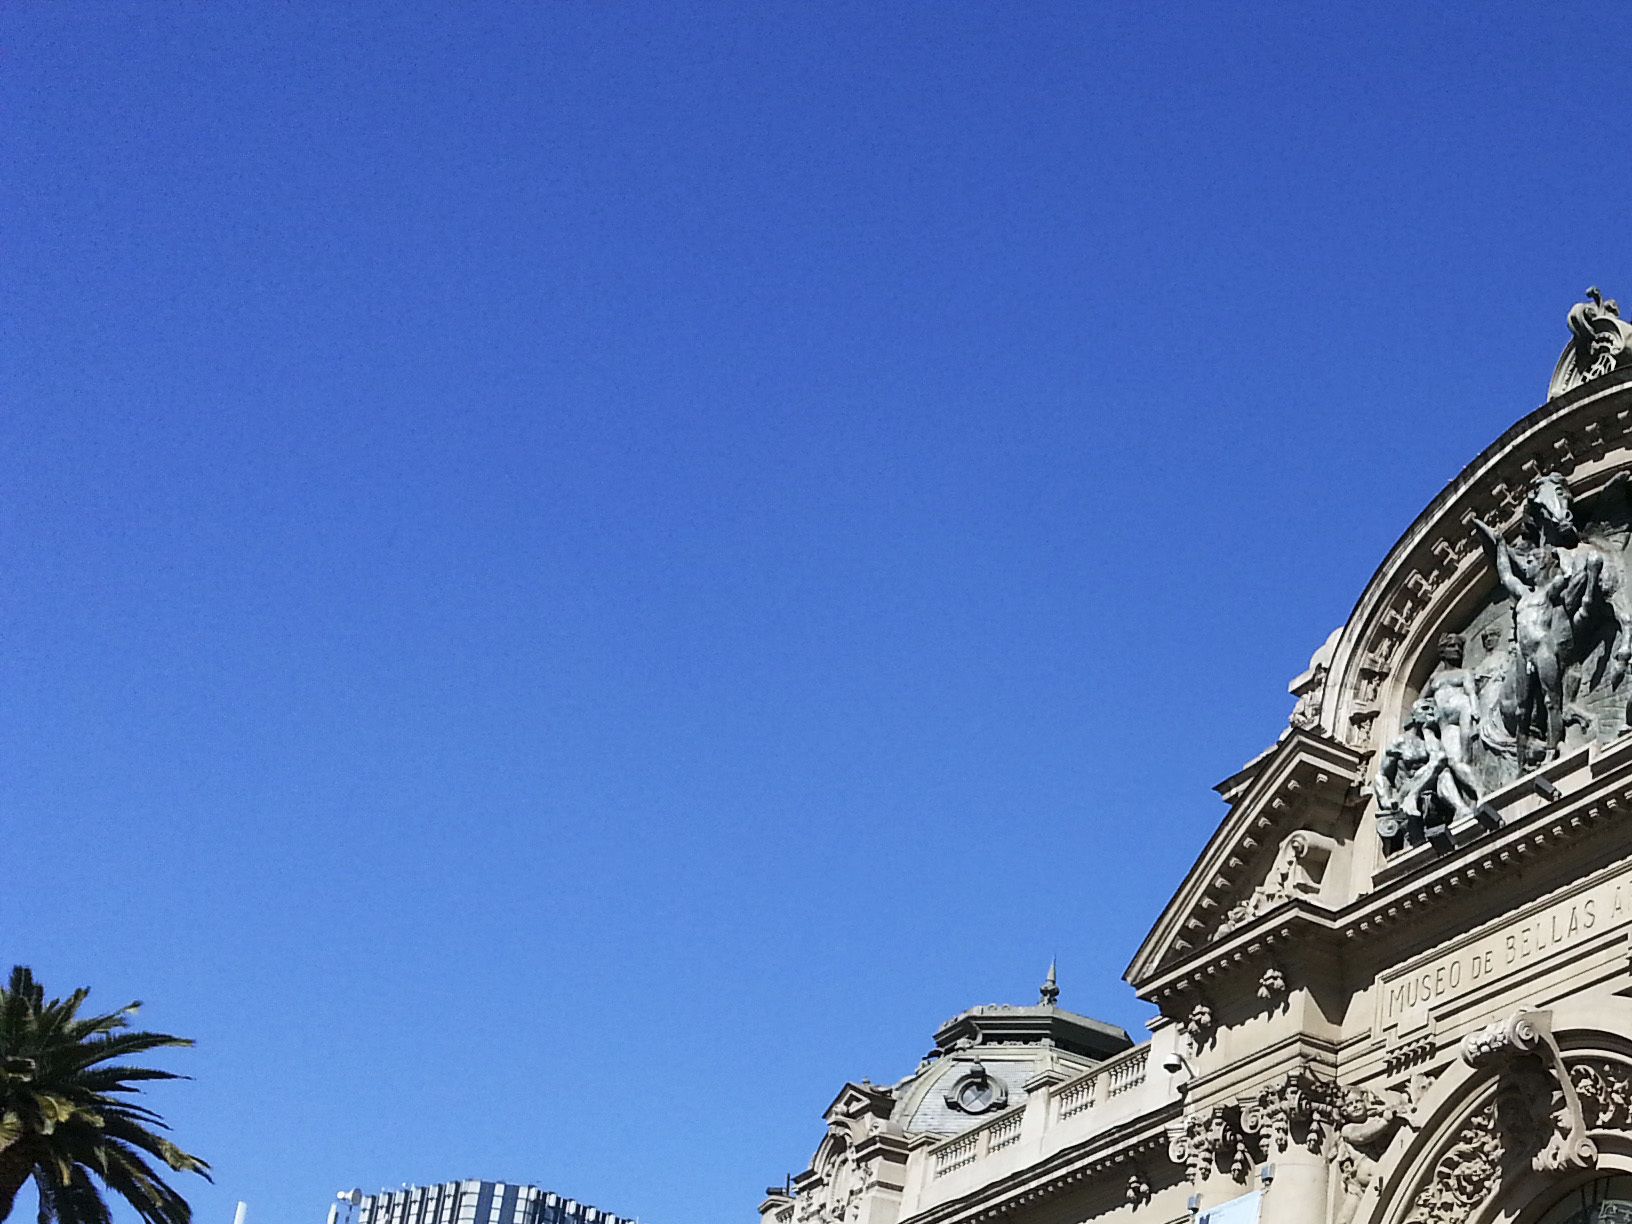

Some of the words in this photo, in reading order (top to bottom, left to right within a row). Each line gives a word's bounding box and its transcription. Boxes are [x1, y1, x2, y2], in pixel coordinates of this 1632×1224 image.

[1388, 960, 1461, 1018] MUSEO
[1472, 950, 1493, 980] DE
[1505, 899, 1596, 964] BELLAS
